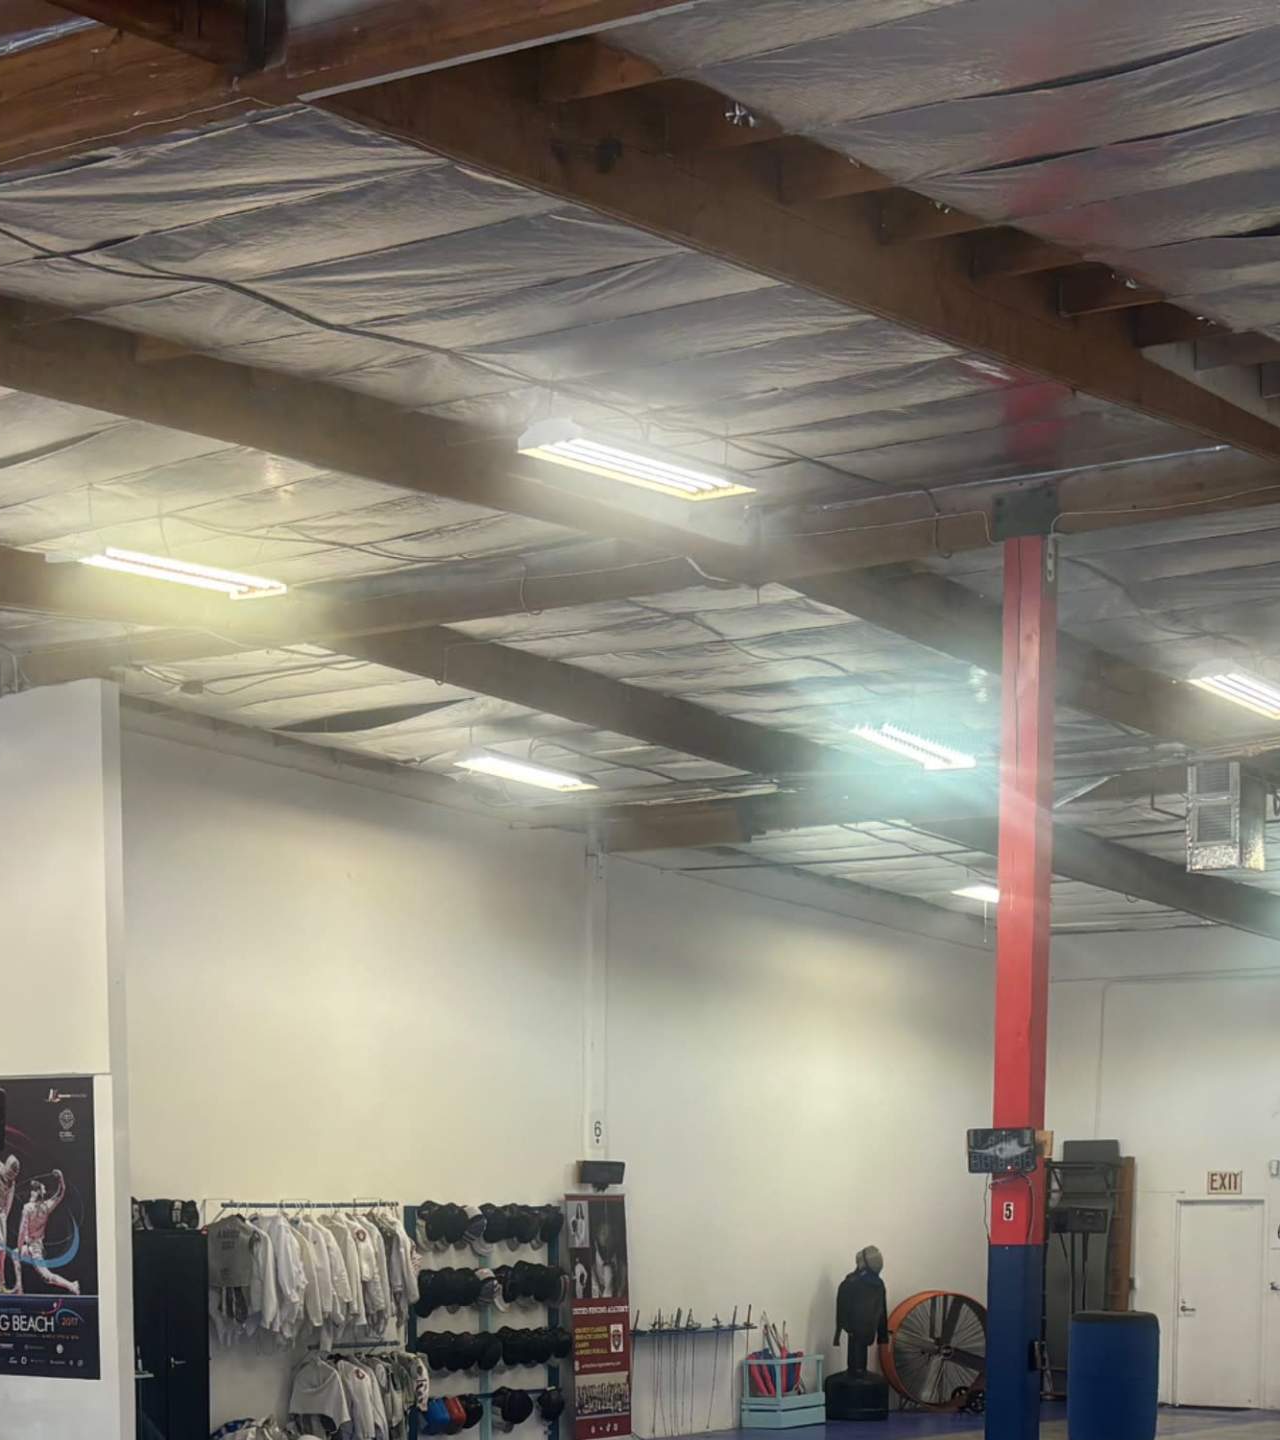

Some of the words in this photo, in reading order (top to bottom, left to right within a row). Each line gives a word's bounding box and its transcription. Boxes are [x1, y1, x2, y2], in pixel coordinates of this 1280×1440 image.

[594, 1121, 601, 1137] 6
[1210, 1172, 1239, 1191] EXIT
[1004, 1203, 1013, 1220] 5
[12, 1315, 55, 1332] BEACH
